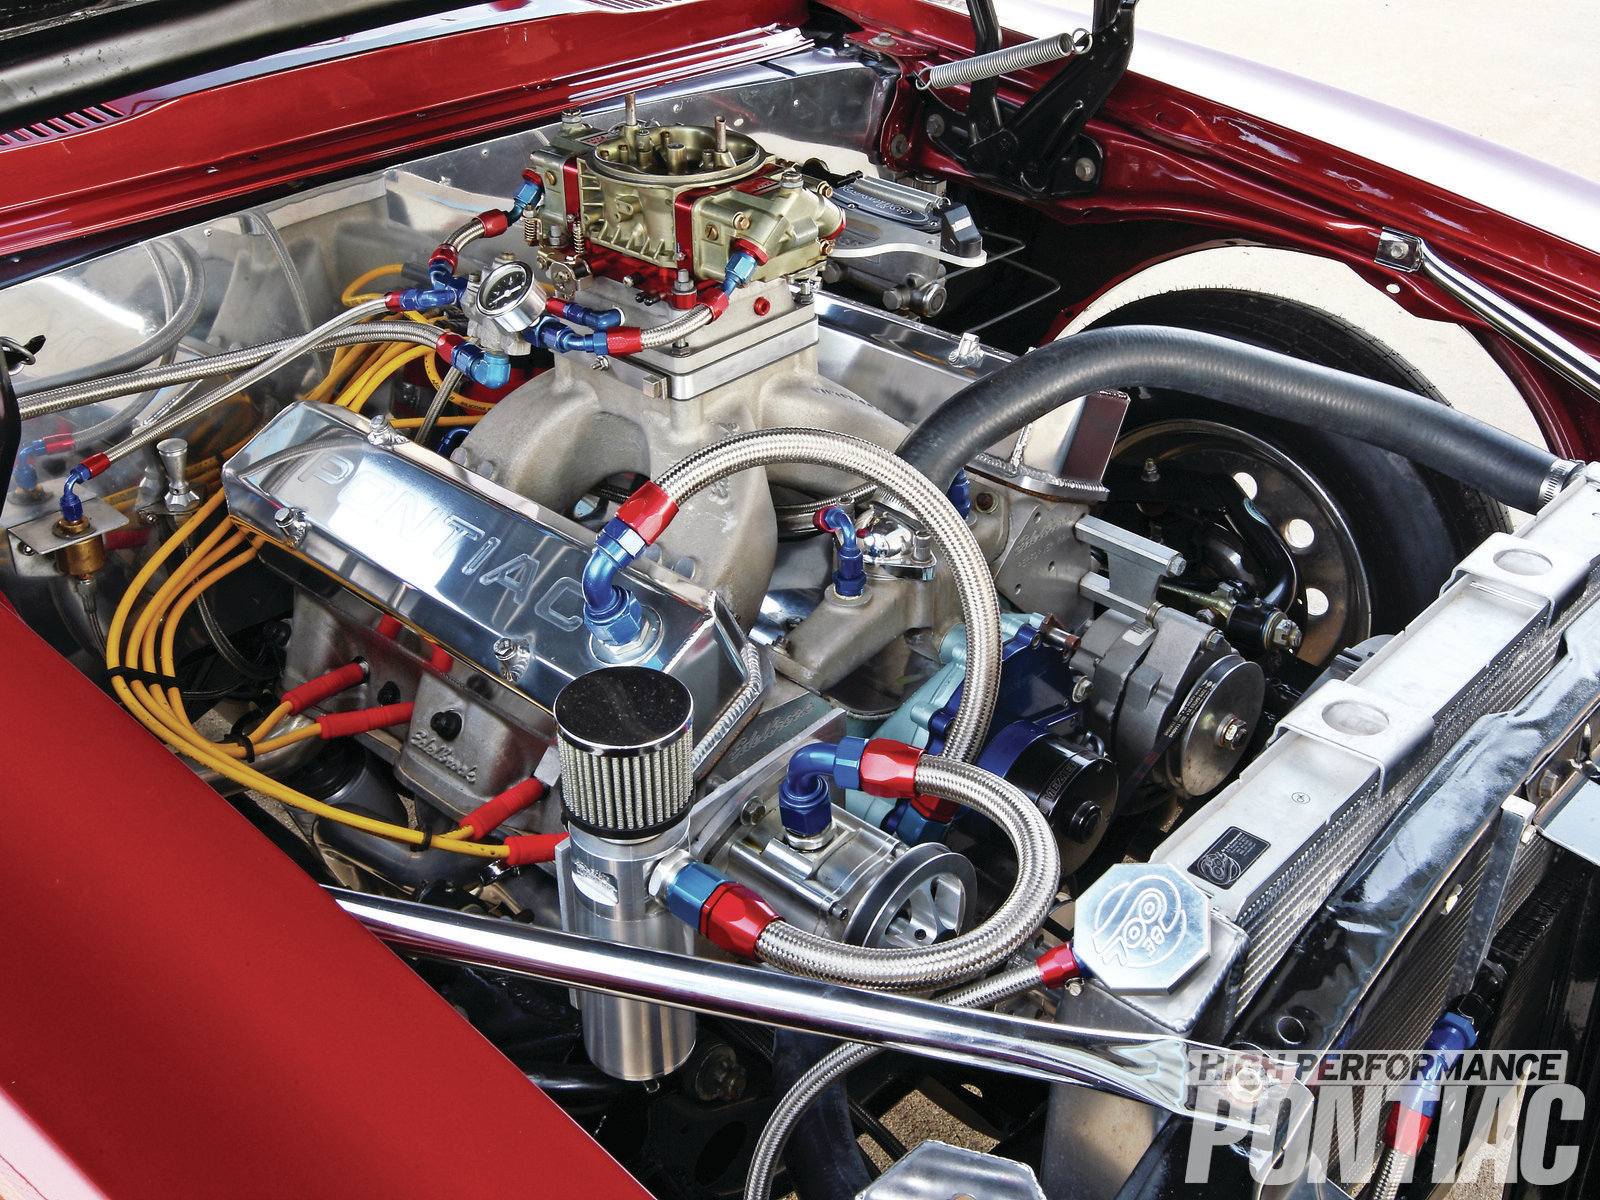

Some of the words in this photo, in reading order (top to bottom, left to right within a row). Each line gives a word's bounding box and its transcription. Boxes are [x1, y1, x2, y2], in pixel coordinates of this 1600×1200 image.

[297, 451, 586, 633] PONTIAC
[410, 729, 478, 783] Edelbrock
[1142, 925, 1165, 958] BE
